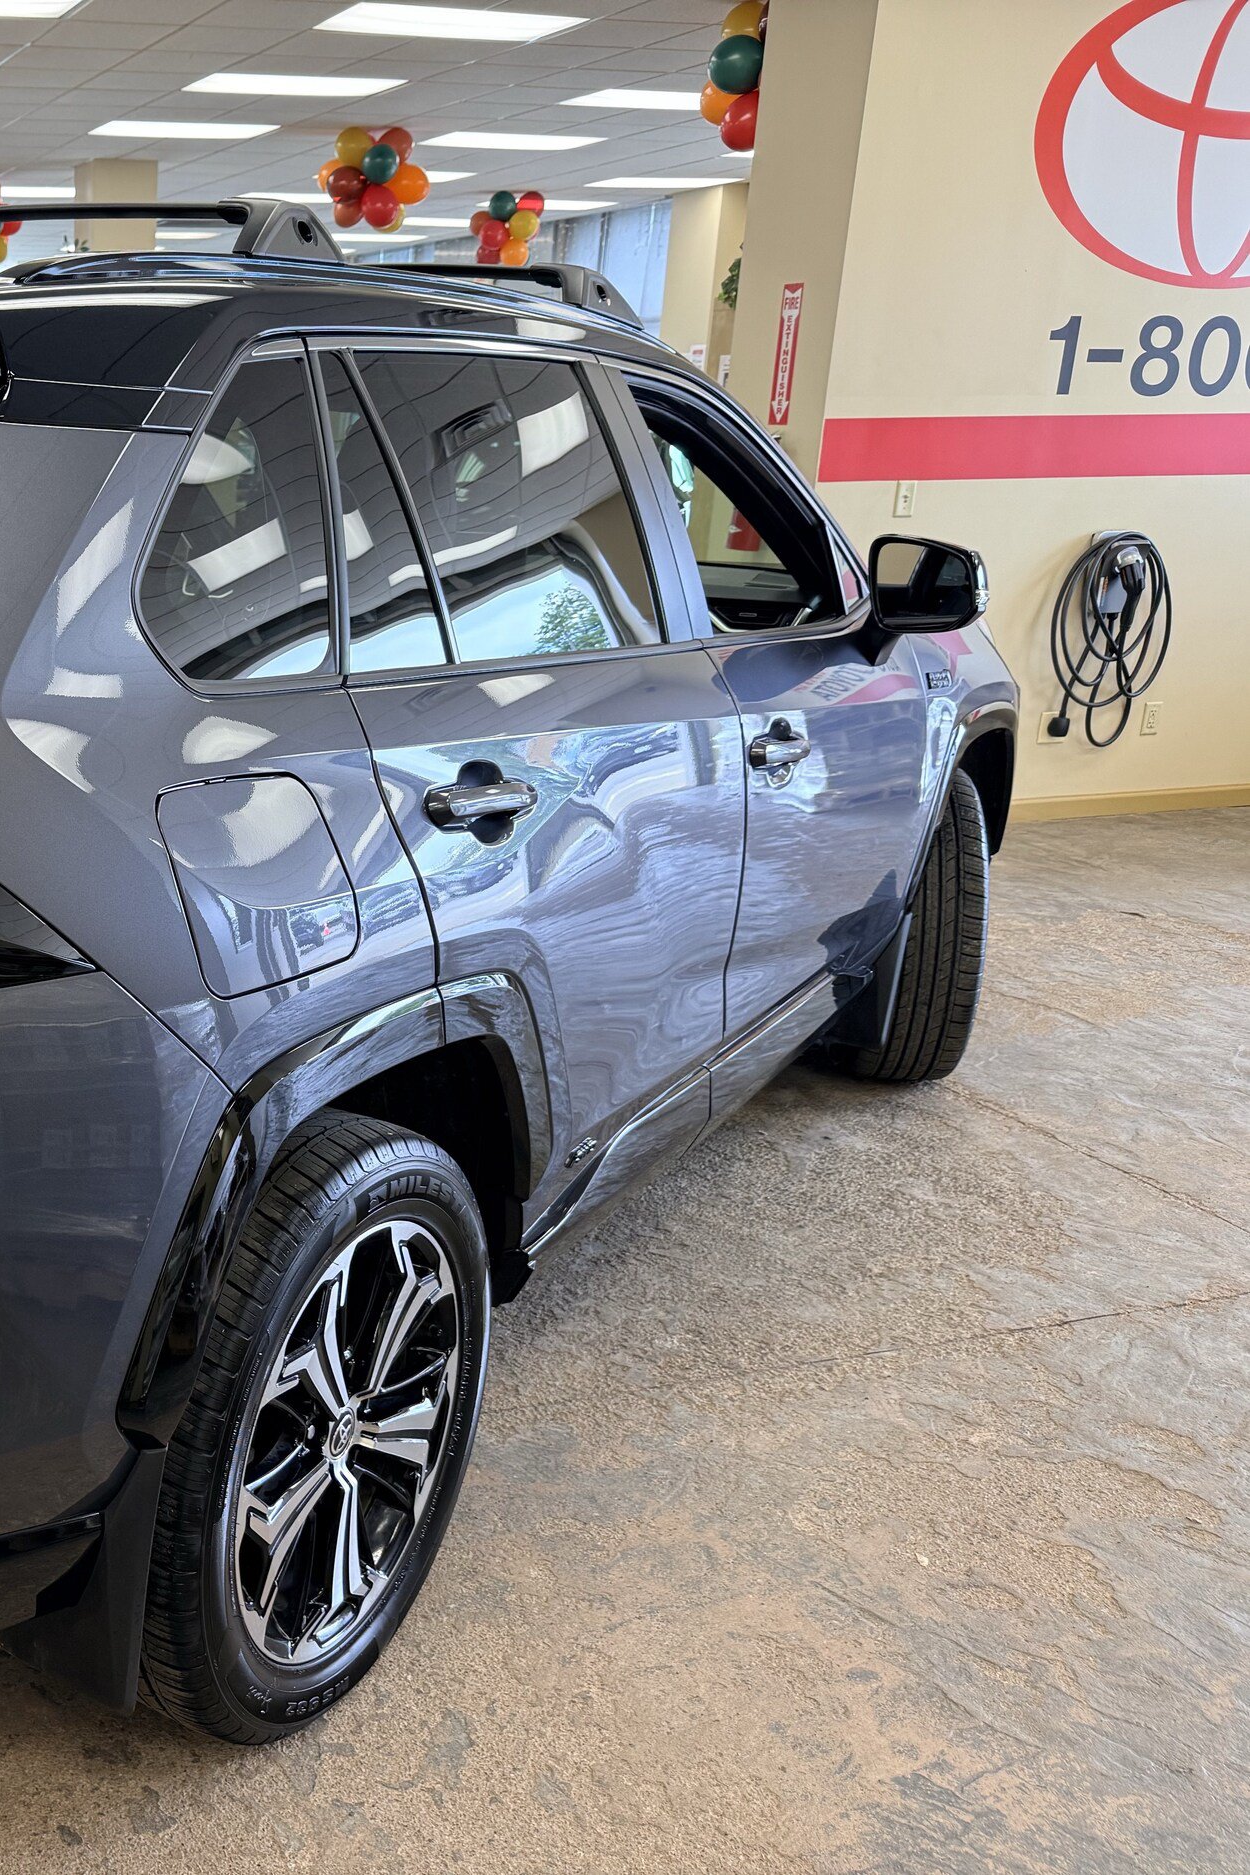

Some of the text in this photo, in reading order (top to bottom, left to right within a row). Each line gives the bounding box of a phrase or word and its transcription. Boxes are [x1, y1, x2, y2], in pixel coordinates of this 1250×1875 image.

[784, 296, 800, 310] FIRE
[776, 315, 793, 415] EXTINGUISHER
[1049, 314, 1250, 397] 1-80
